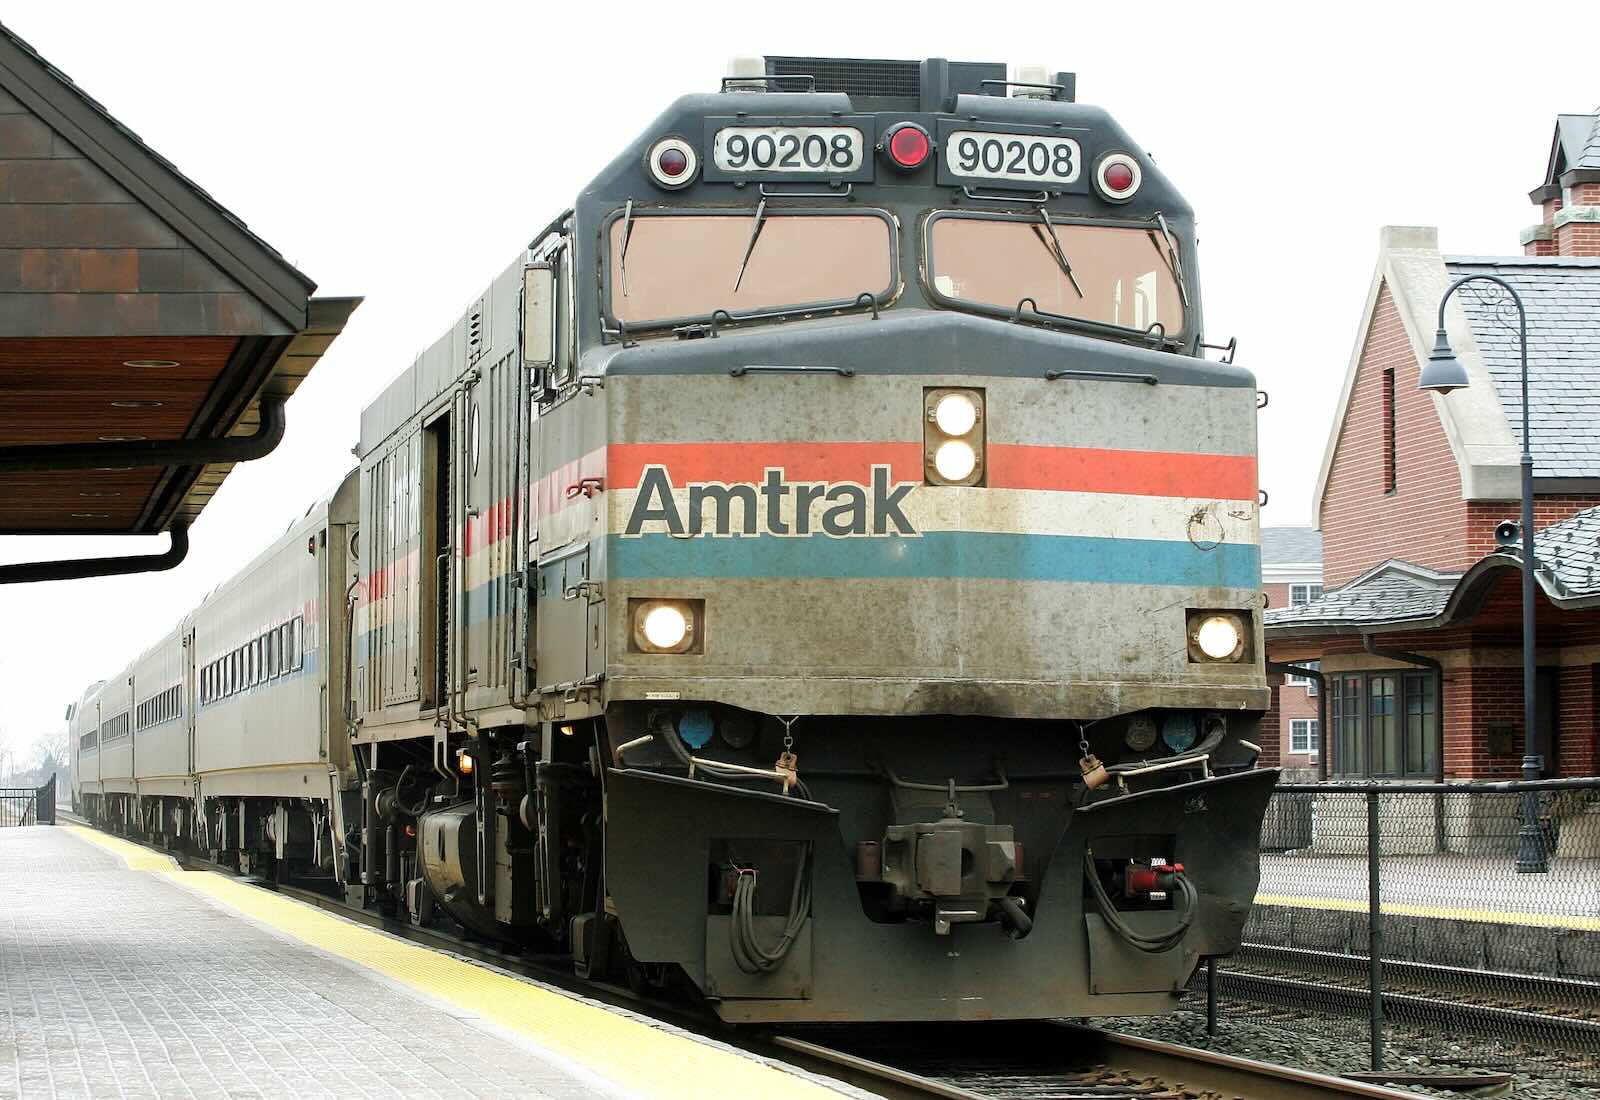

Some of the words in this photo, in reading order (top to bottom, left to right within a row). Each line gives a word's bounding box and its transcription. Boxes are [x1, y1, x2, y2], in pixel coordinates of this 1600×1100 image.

[726, 134, 854, 169] 90208
[958, 137, 1073, 178] 90208
[623, 465, 919, 536] Amtrak
